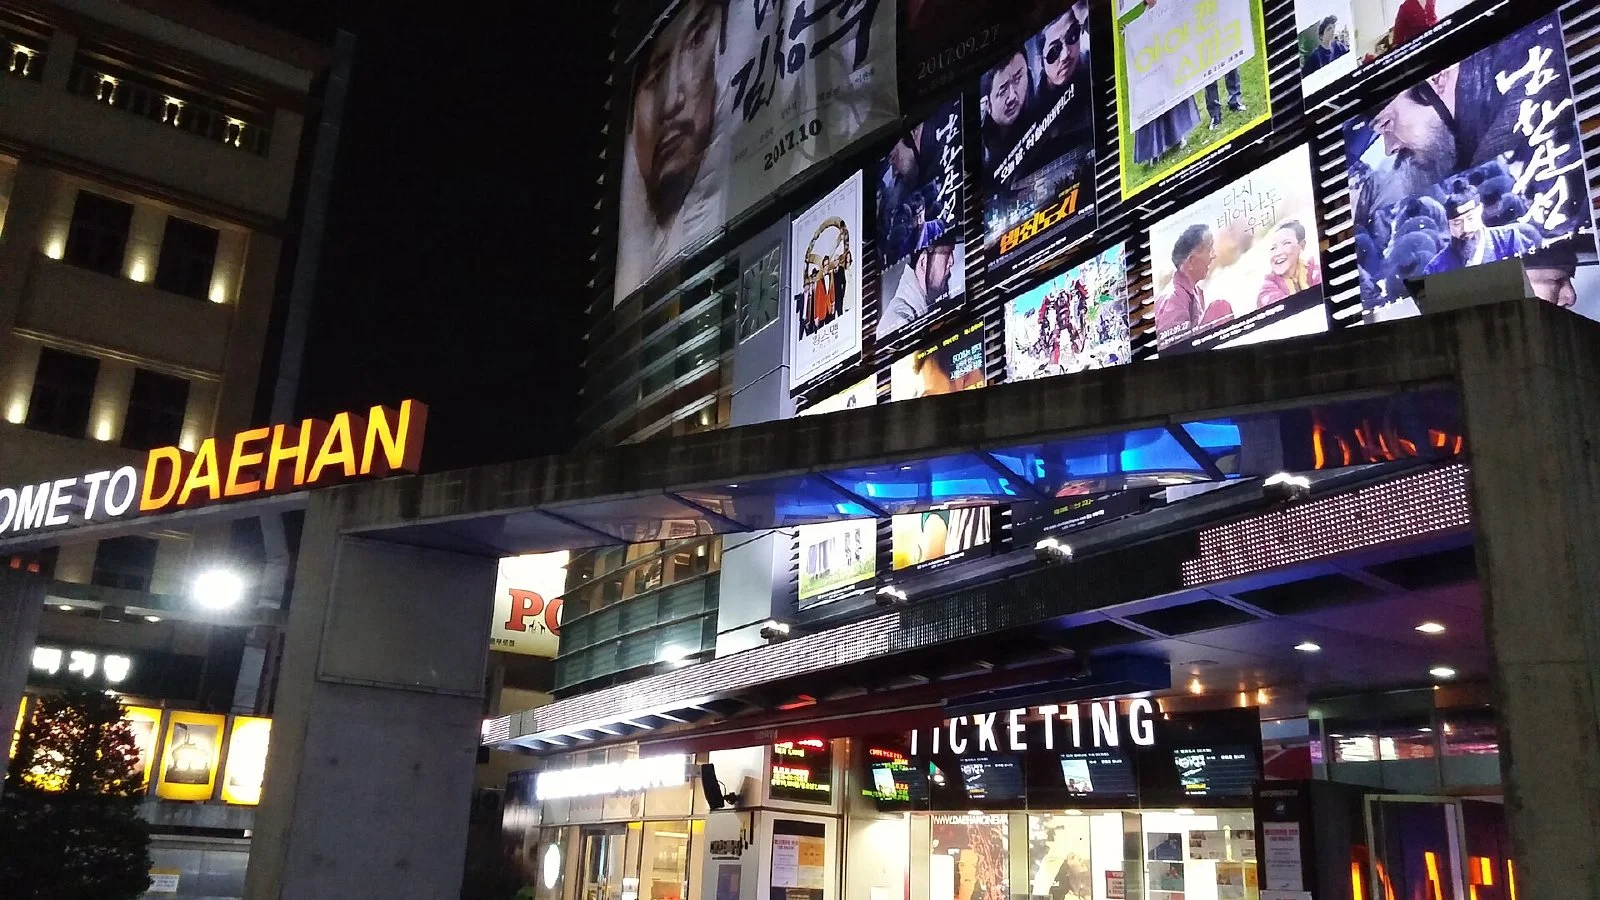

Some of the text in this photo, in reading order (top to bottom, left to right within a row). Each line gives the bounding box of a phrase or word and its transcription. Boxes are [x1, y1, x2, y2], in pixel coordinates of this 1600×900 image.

[917, 23, 1000, 80] 2017.09.27
[1134, 21, 1190, 74] 아이
[1173, 18, 1243, 87] 스피크
[763, 118, 823, 172] 2017.10
[1494, 45, 1584, 231] 남한산성
[1216, 188, 1282, 229] 태어나도
[1223, 179, 1253, 207] 다시
[1000, 188, 1079, 255] 범죄도시
[1244, 205, 1277, 236] 우리
[812, 322, 839, 346] 킹스맨
[84, 465, 138, 520] TO
[140, 399, 412, 511] DAEHAN
